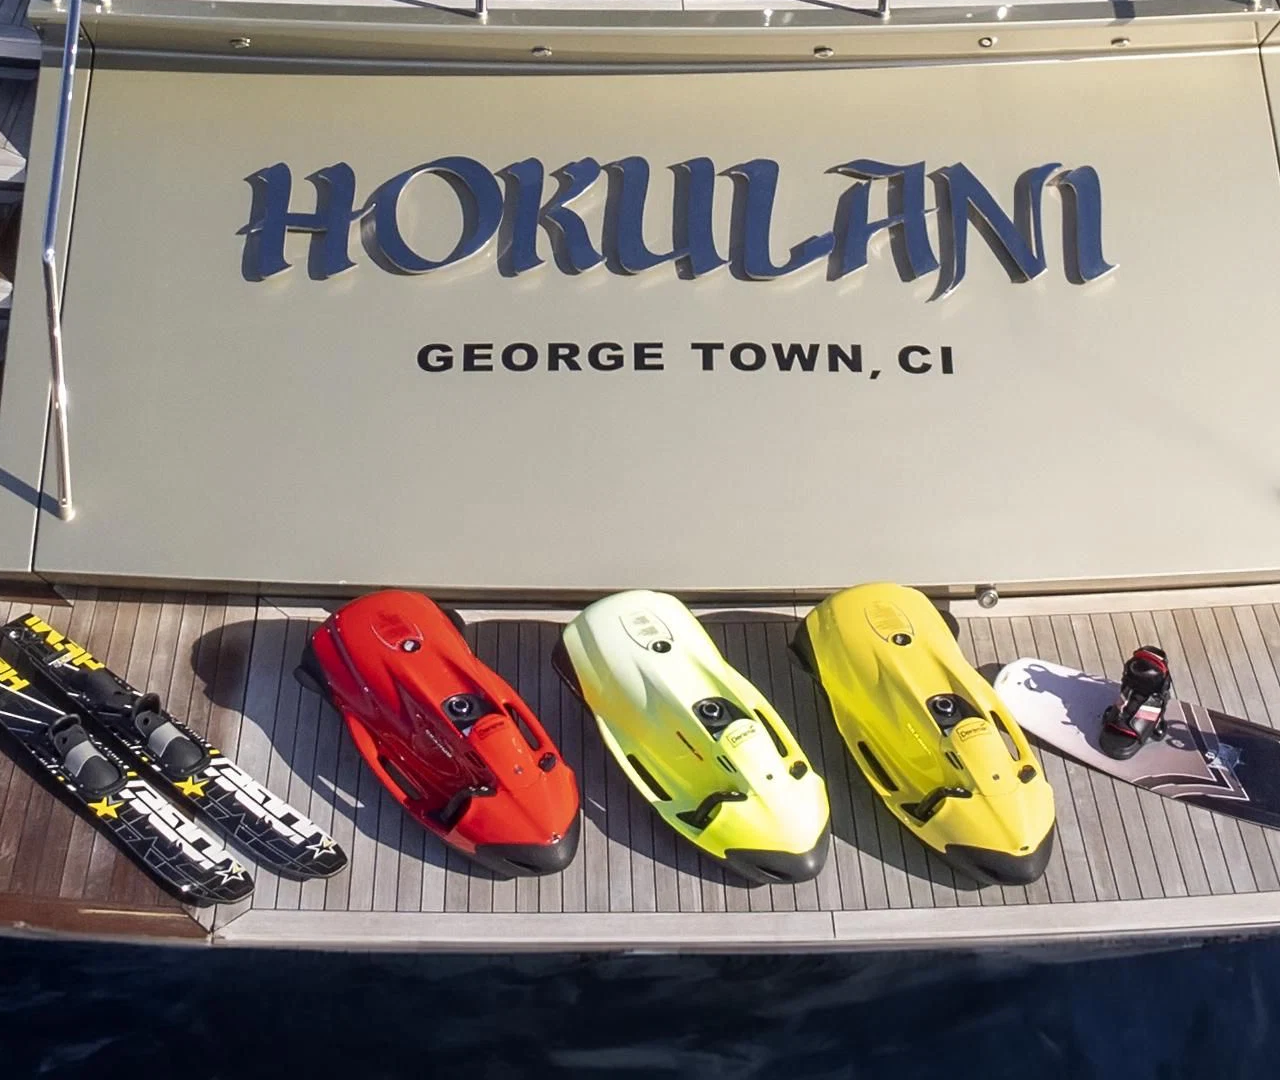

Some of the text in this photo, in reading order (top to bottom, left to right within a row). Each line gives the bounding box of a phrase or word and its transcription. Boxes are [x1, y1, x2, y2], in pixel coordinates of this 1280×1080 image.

[237, 155, 1118, 302] HOKULANI
[416, 342, 954, 380] GEORGE TOWN, CI
